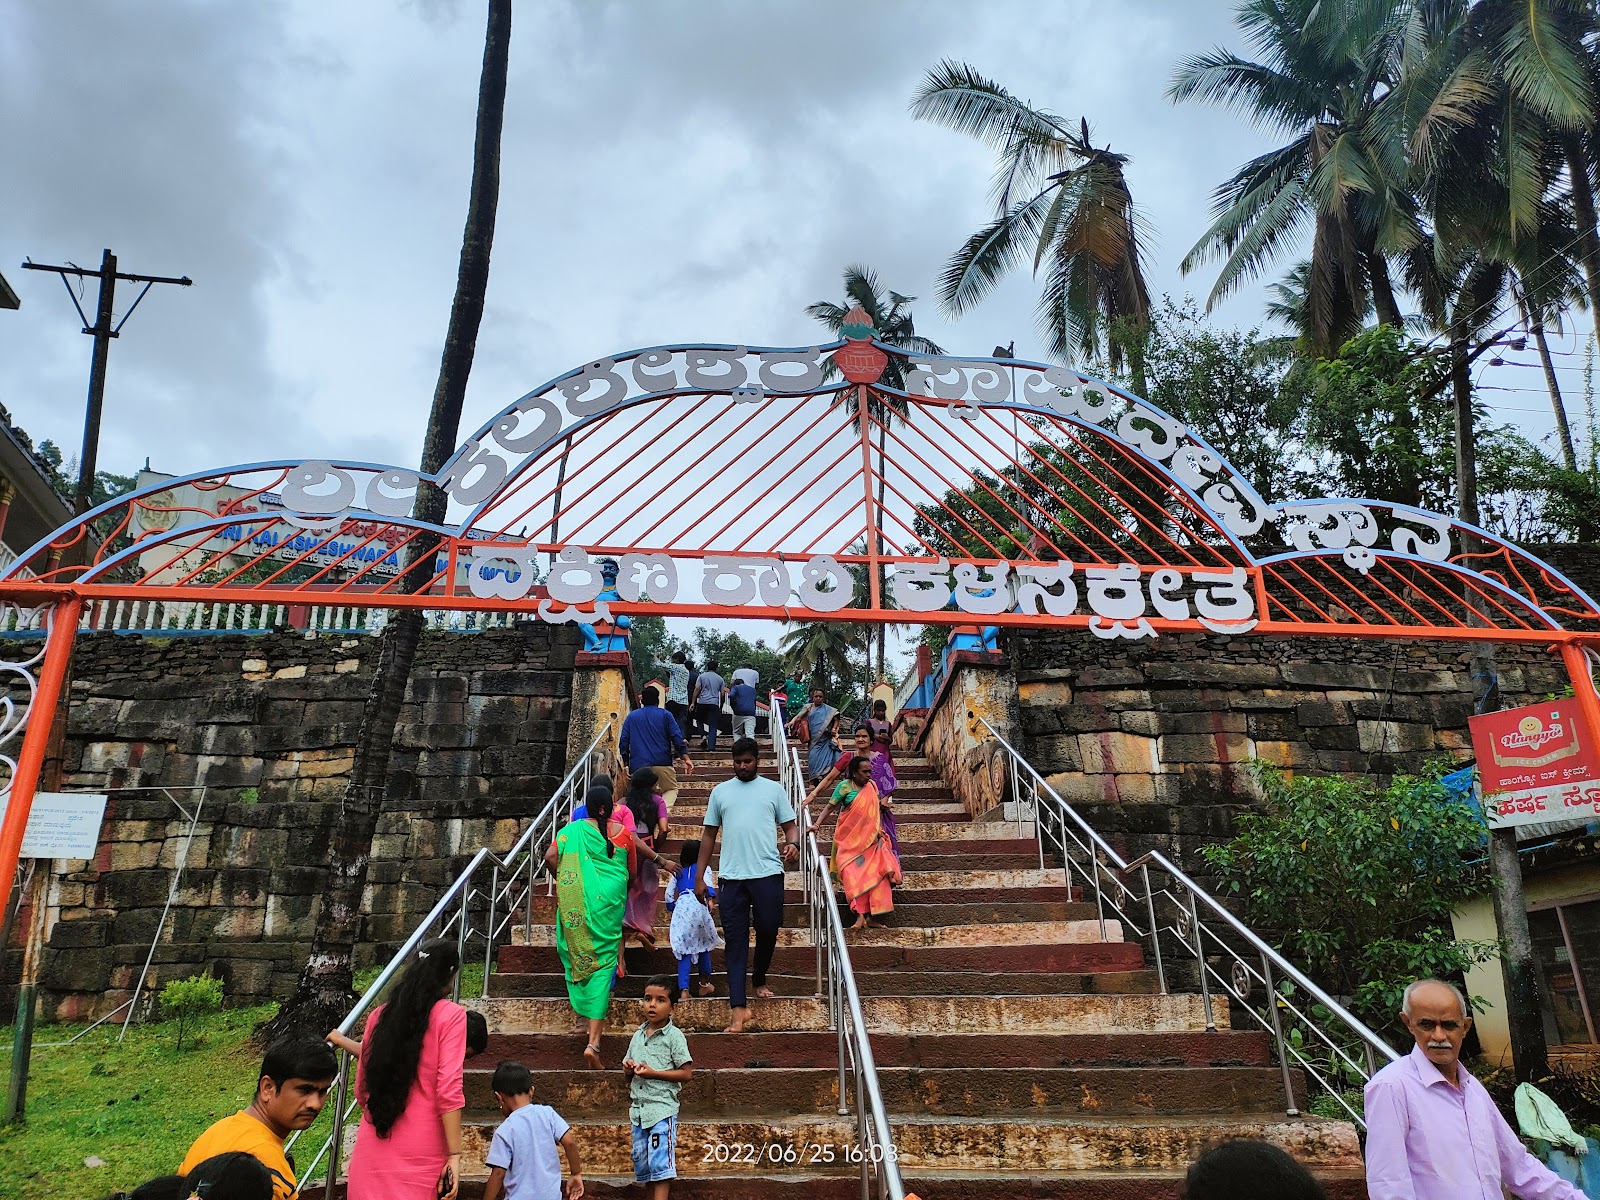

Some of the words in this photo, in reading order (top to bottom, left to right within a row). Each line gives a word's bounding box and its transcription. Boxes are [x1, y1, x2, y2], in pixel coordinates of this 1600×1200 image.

[281, 461, 420, 529] ಶ್ರೀ
[435, 346, 823, 506] ಕಲಶೇಶ್ವರ
[468, 544, 679, 624] ದಕ್ಷಿಣ
[702, 555, 854, 613] ಕಾಶಿ
[1497, 793, 1548, 816] ಹರ್ಷ
